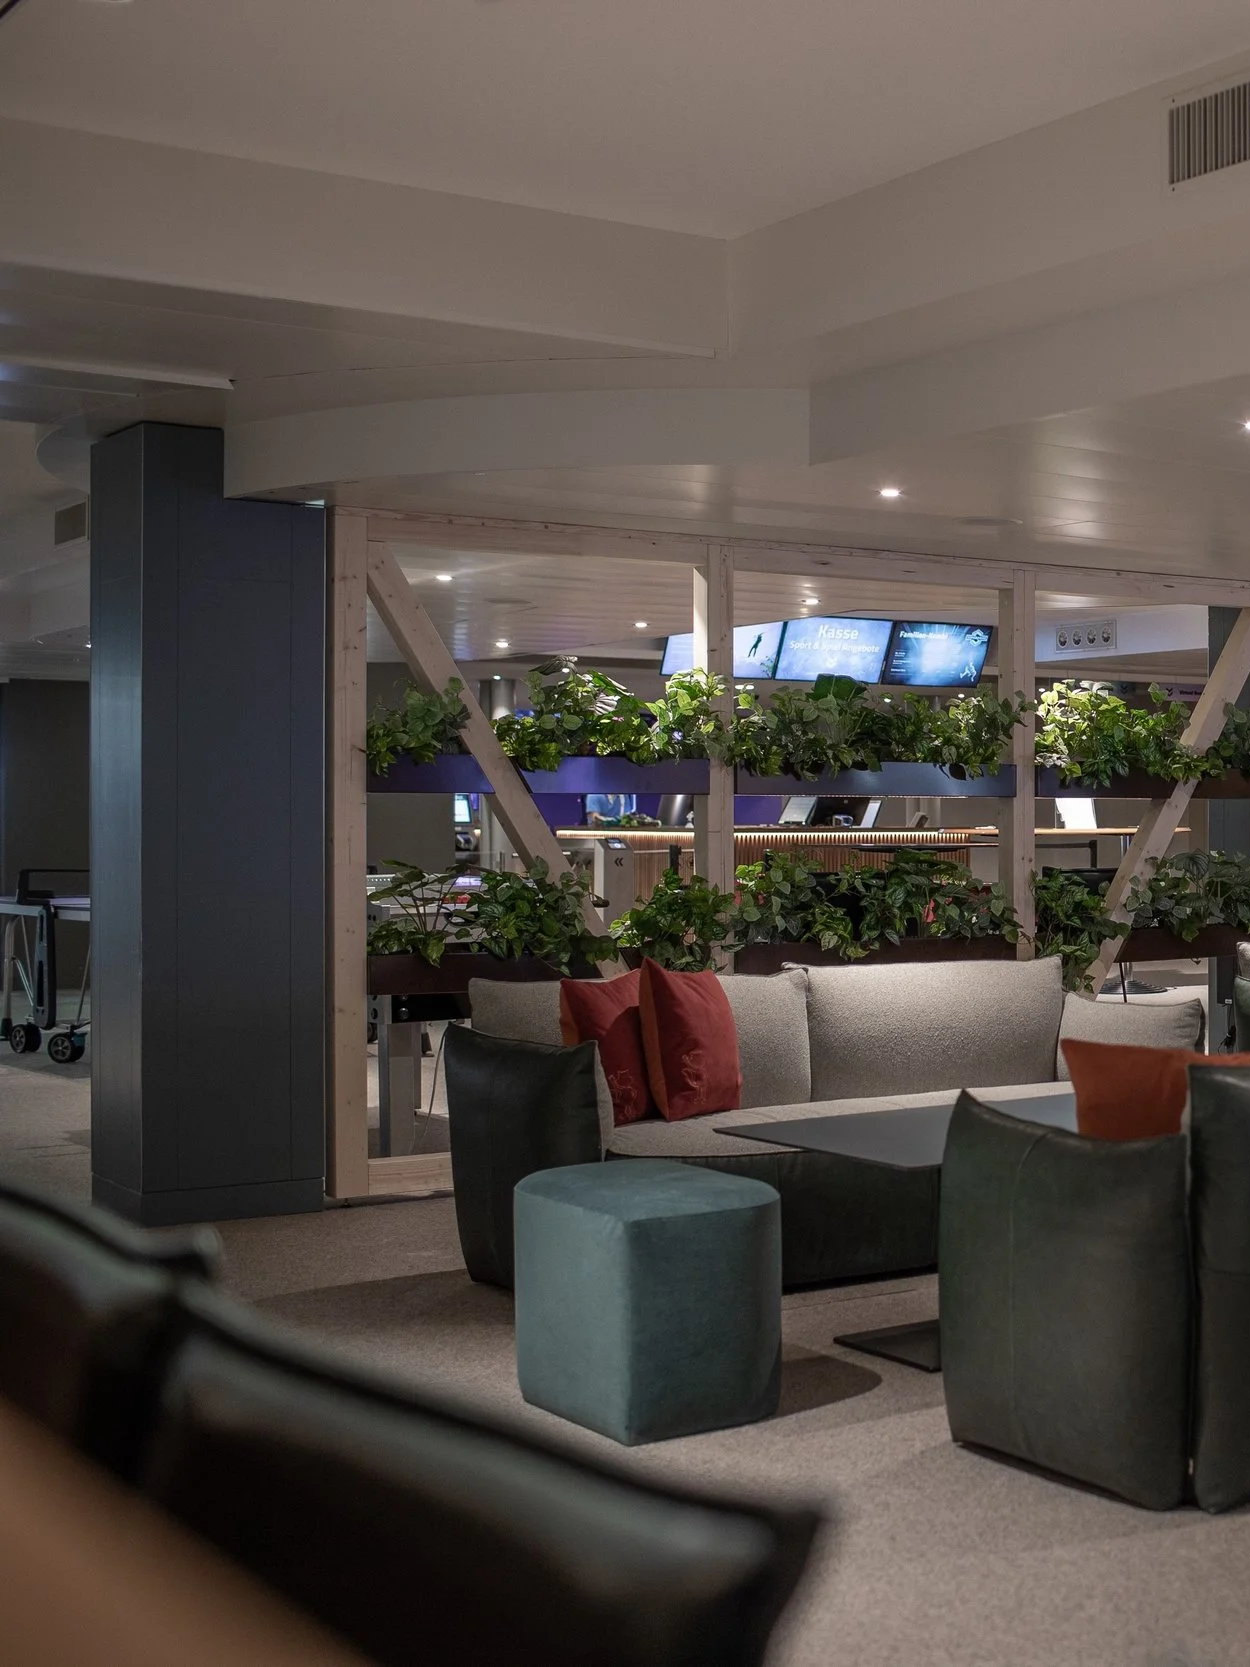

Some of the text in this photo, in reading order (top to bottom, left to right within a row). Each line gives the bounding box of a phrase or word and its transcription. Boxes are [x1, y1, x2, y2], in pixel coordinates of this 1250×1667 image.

[818, 624, 859, 640] Kasse
[789, 640, 812, 650] Sport
[822, 642, 841, 653] Spiel
[842, 644, 880, 654] Angebote
